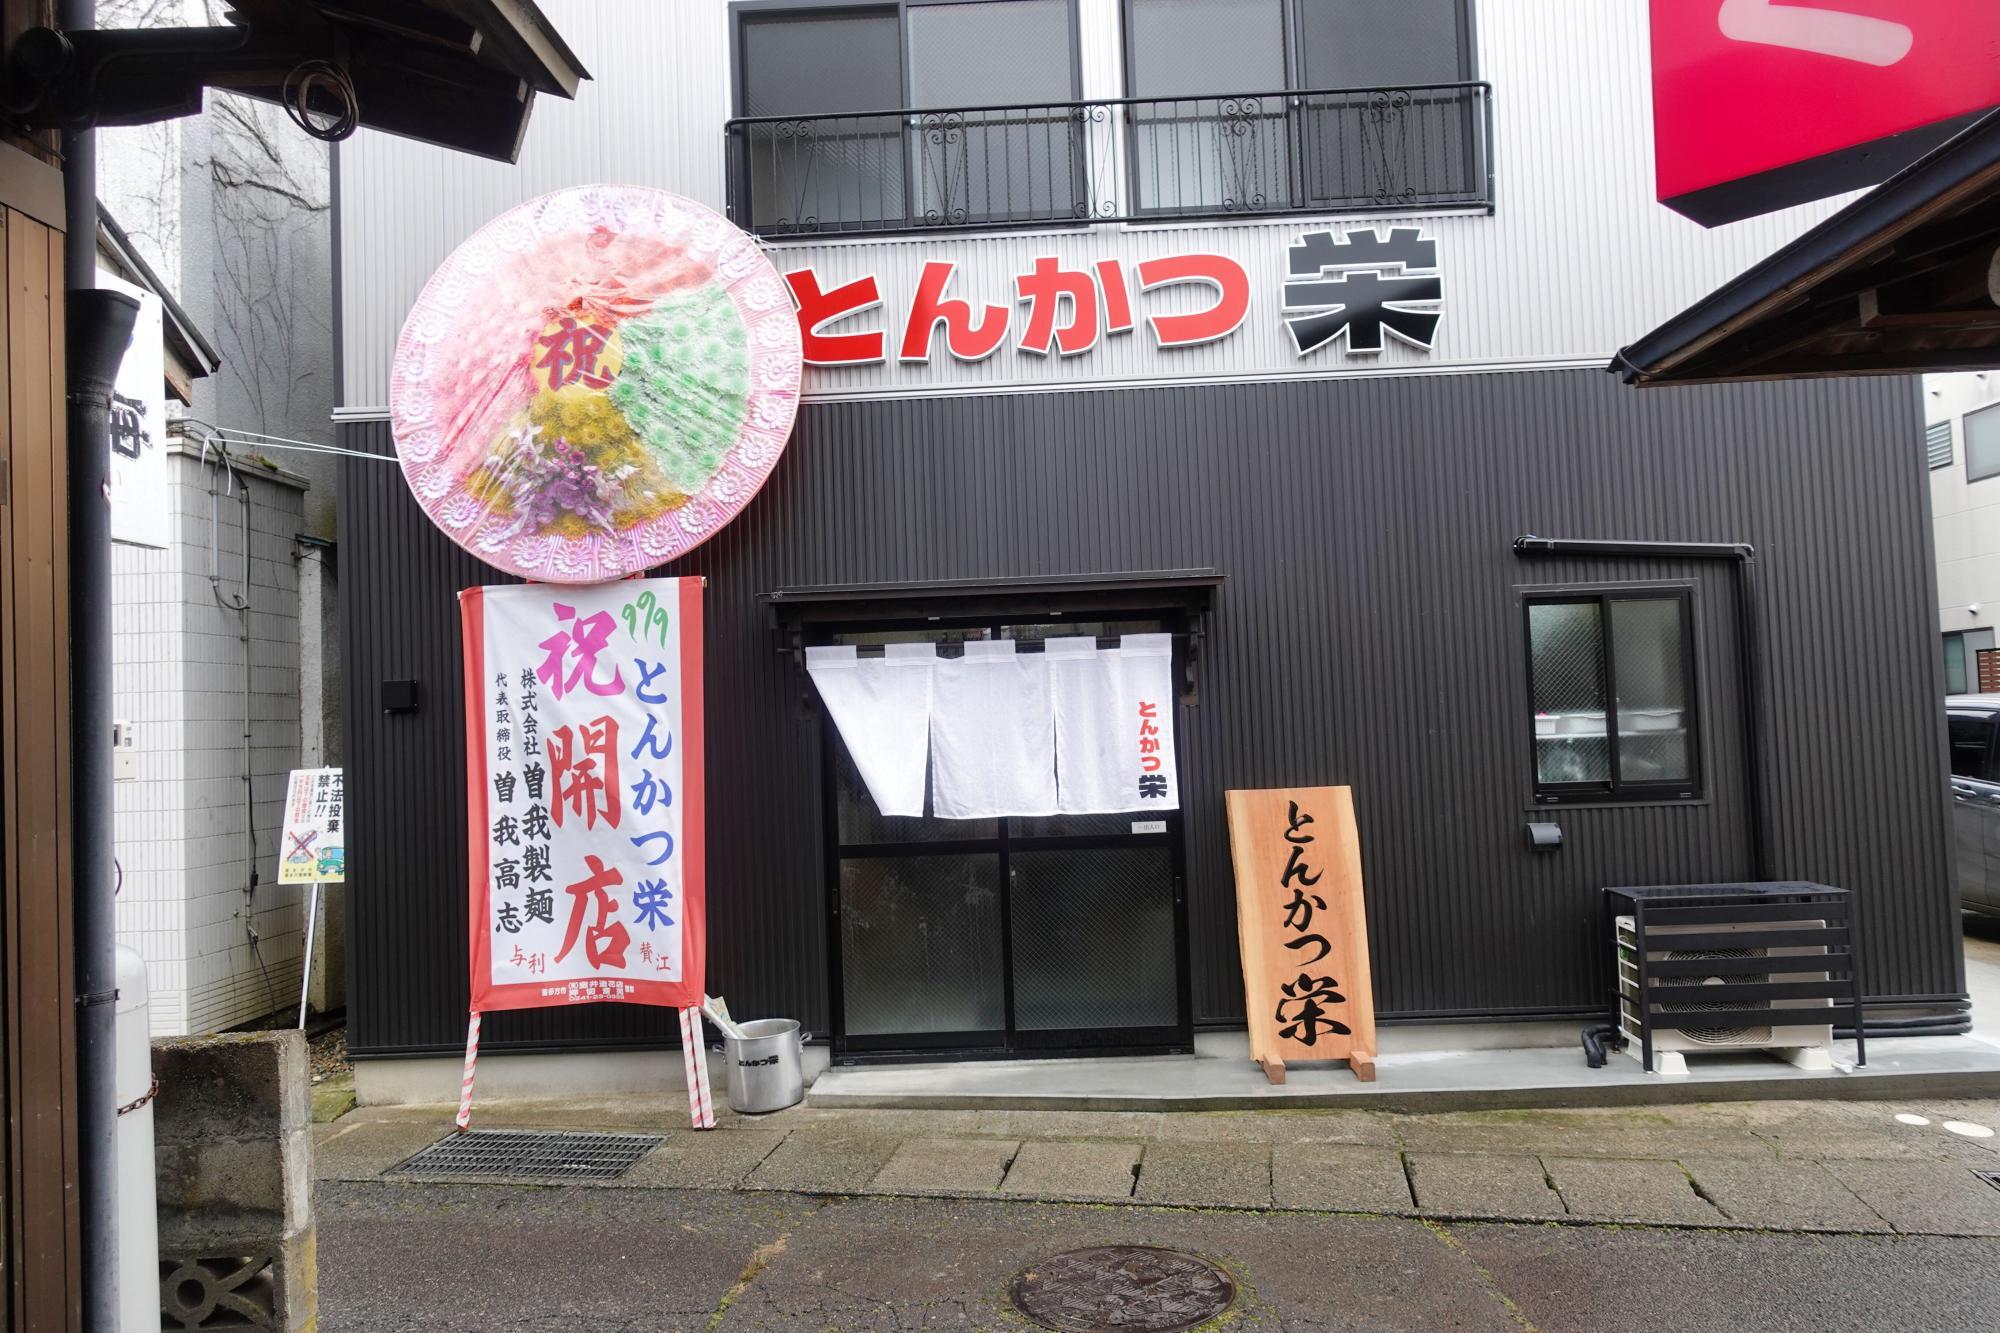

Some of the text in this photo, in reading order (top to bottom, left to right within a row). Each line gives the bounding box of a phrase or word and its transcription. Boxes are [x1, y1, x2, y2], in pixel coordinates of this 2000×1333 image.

[536, 318, 616, 392] 祝
[630, 658, 676, 932] とんかつ栄
[1138, 701, 1168, 799] とんかつ栄
[326, 774, 344, 833] 不法投棄
[1275, 800, 1352, 1047] とんかつ栄
